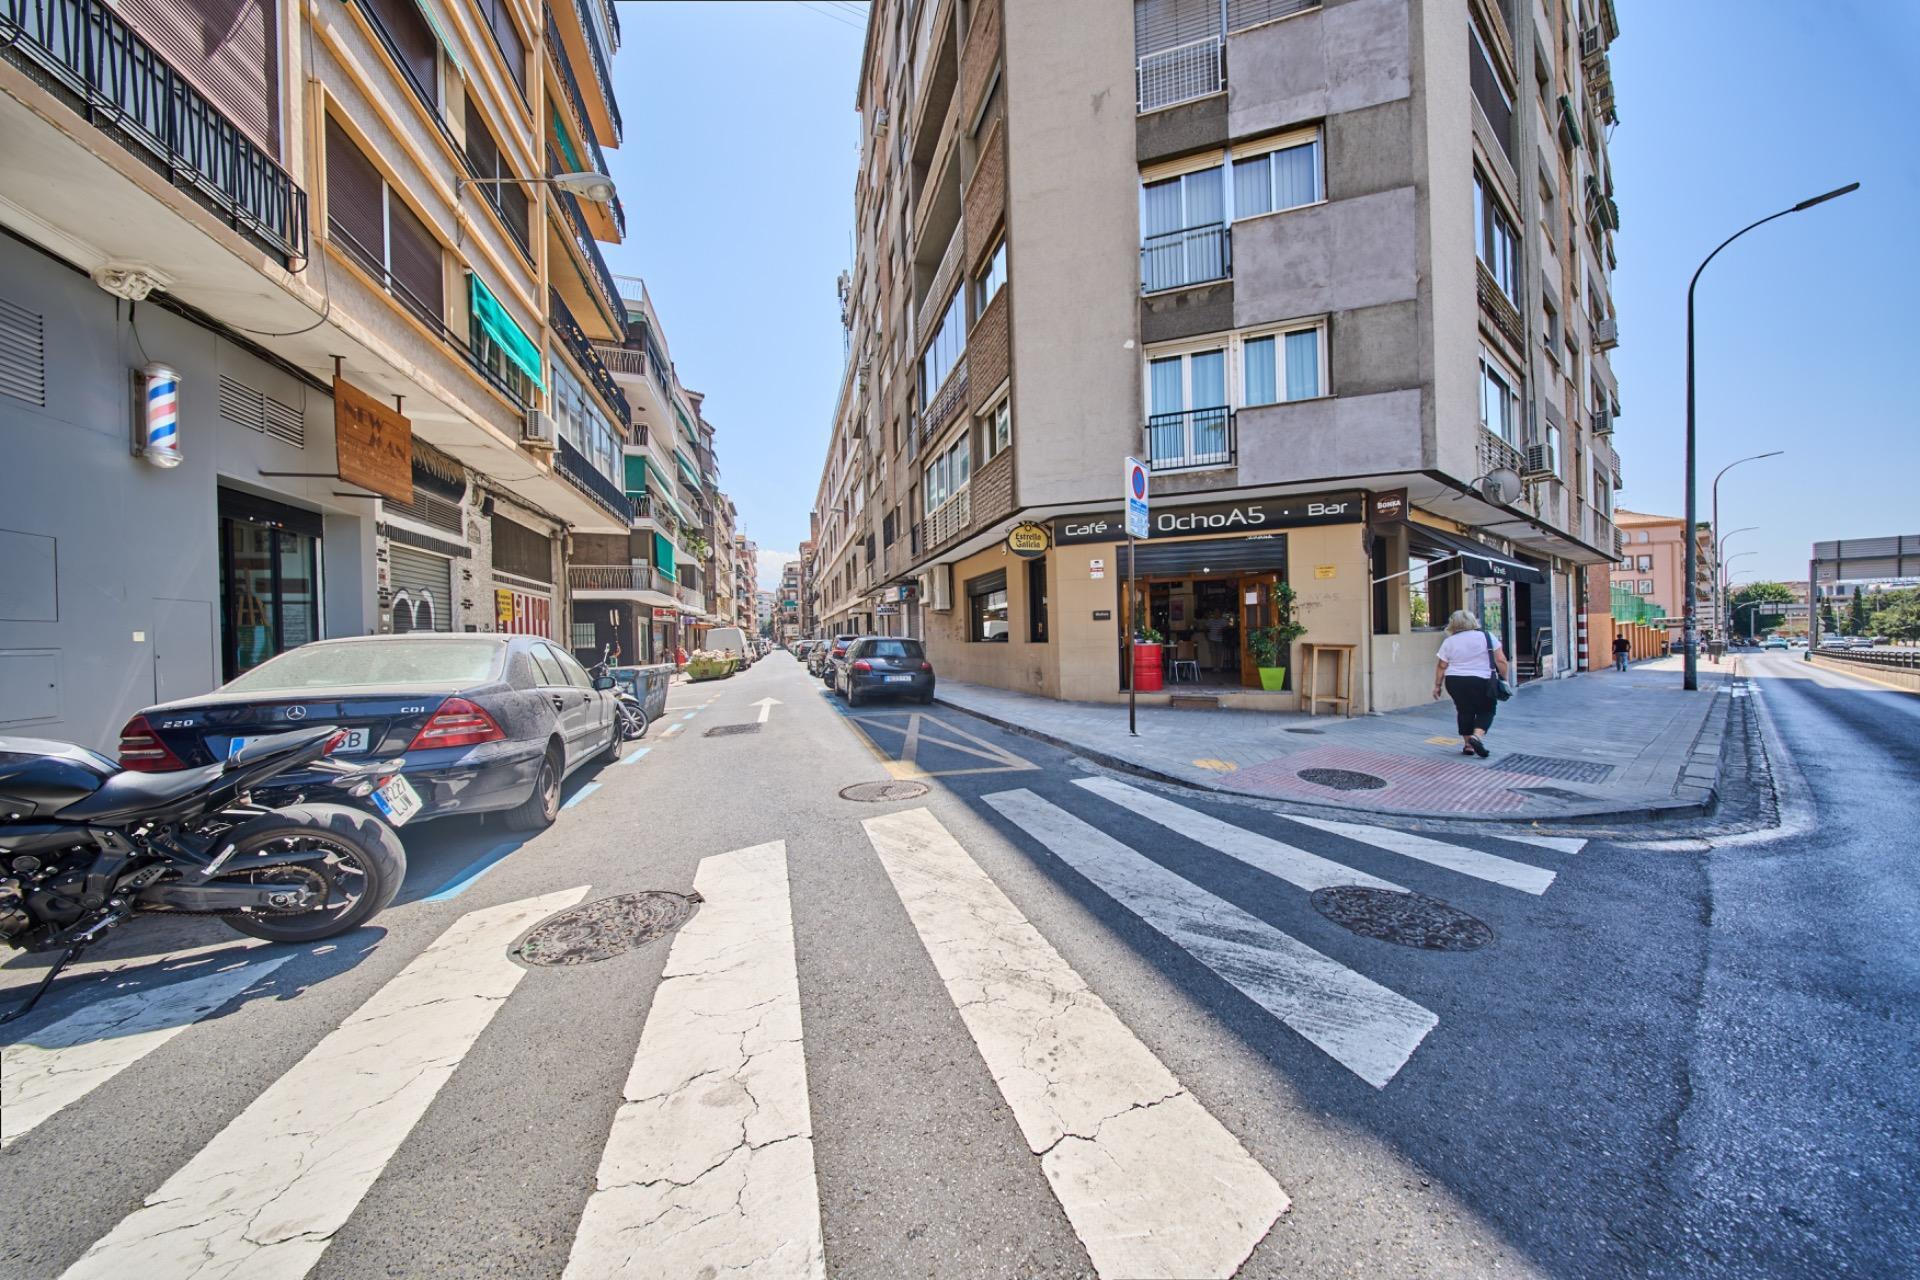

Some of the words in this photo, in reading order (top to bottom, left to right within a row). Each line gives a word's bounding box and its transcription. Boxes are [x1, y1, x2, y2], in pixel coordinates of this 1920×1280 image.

[1377, 500, 1401, 509] BONKA
[1065, 520, 1108, 536] Café
[1157, 506, 1266, 532] OchoA5
[1307, 502, 1349, 517] Bar
[1015, 532, 1042, 541] Estrella
[1015, 540, 1041, 549] Galicia
[400, 705, 426, 714] CDI
[162, 718, 194, 729] 220
